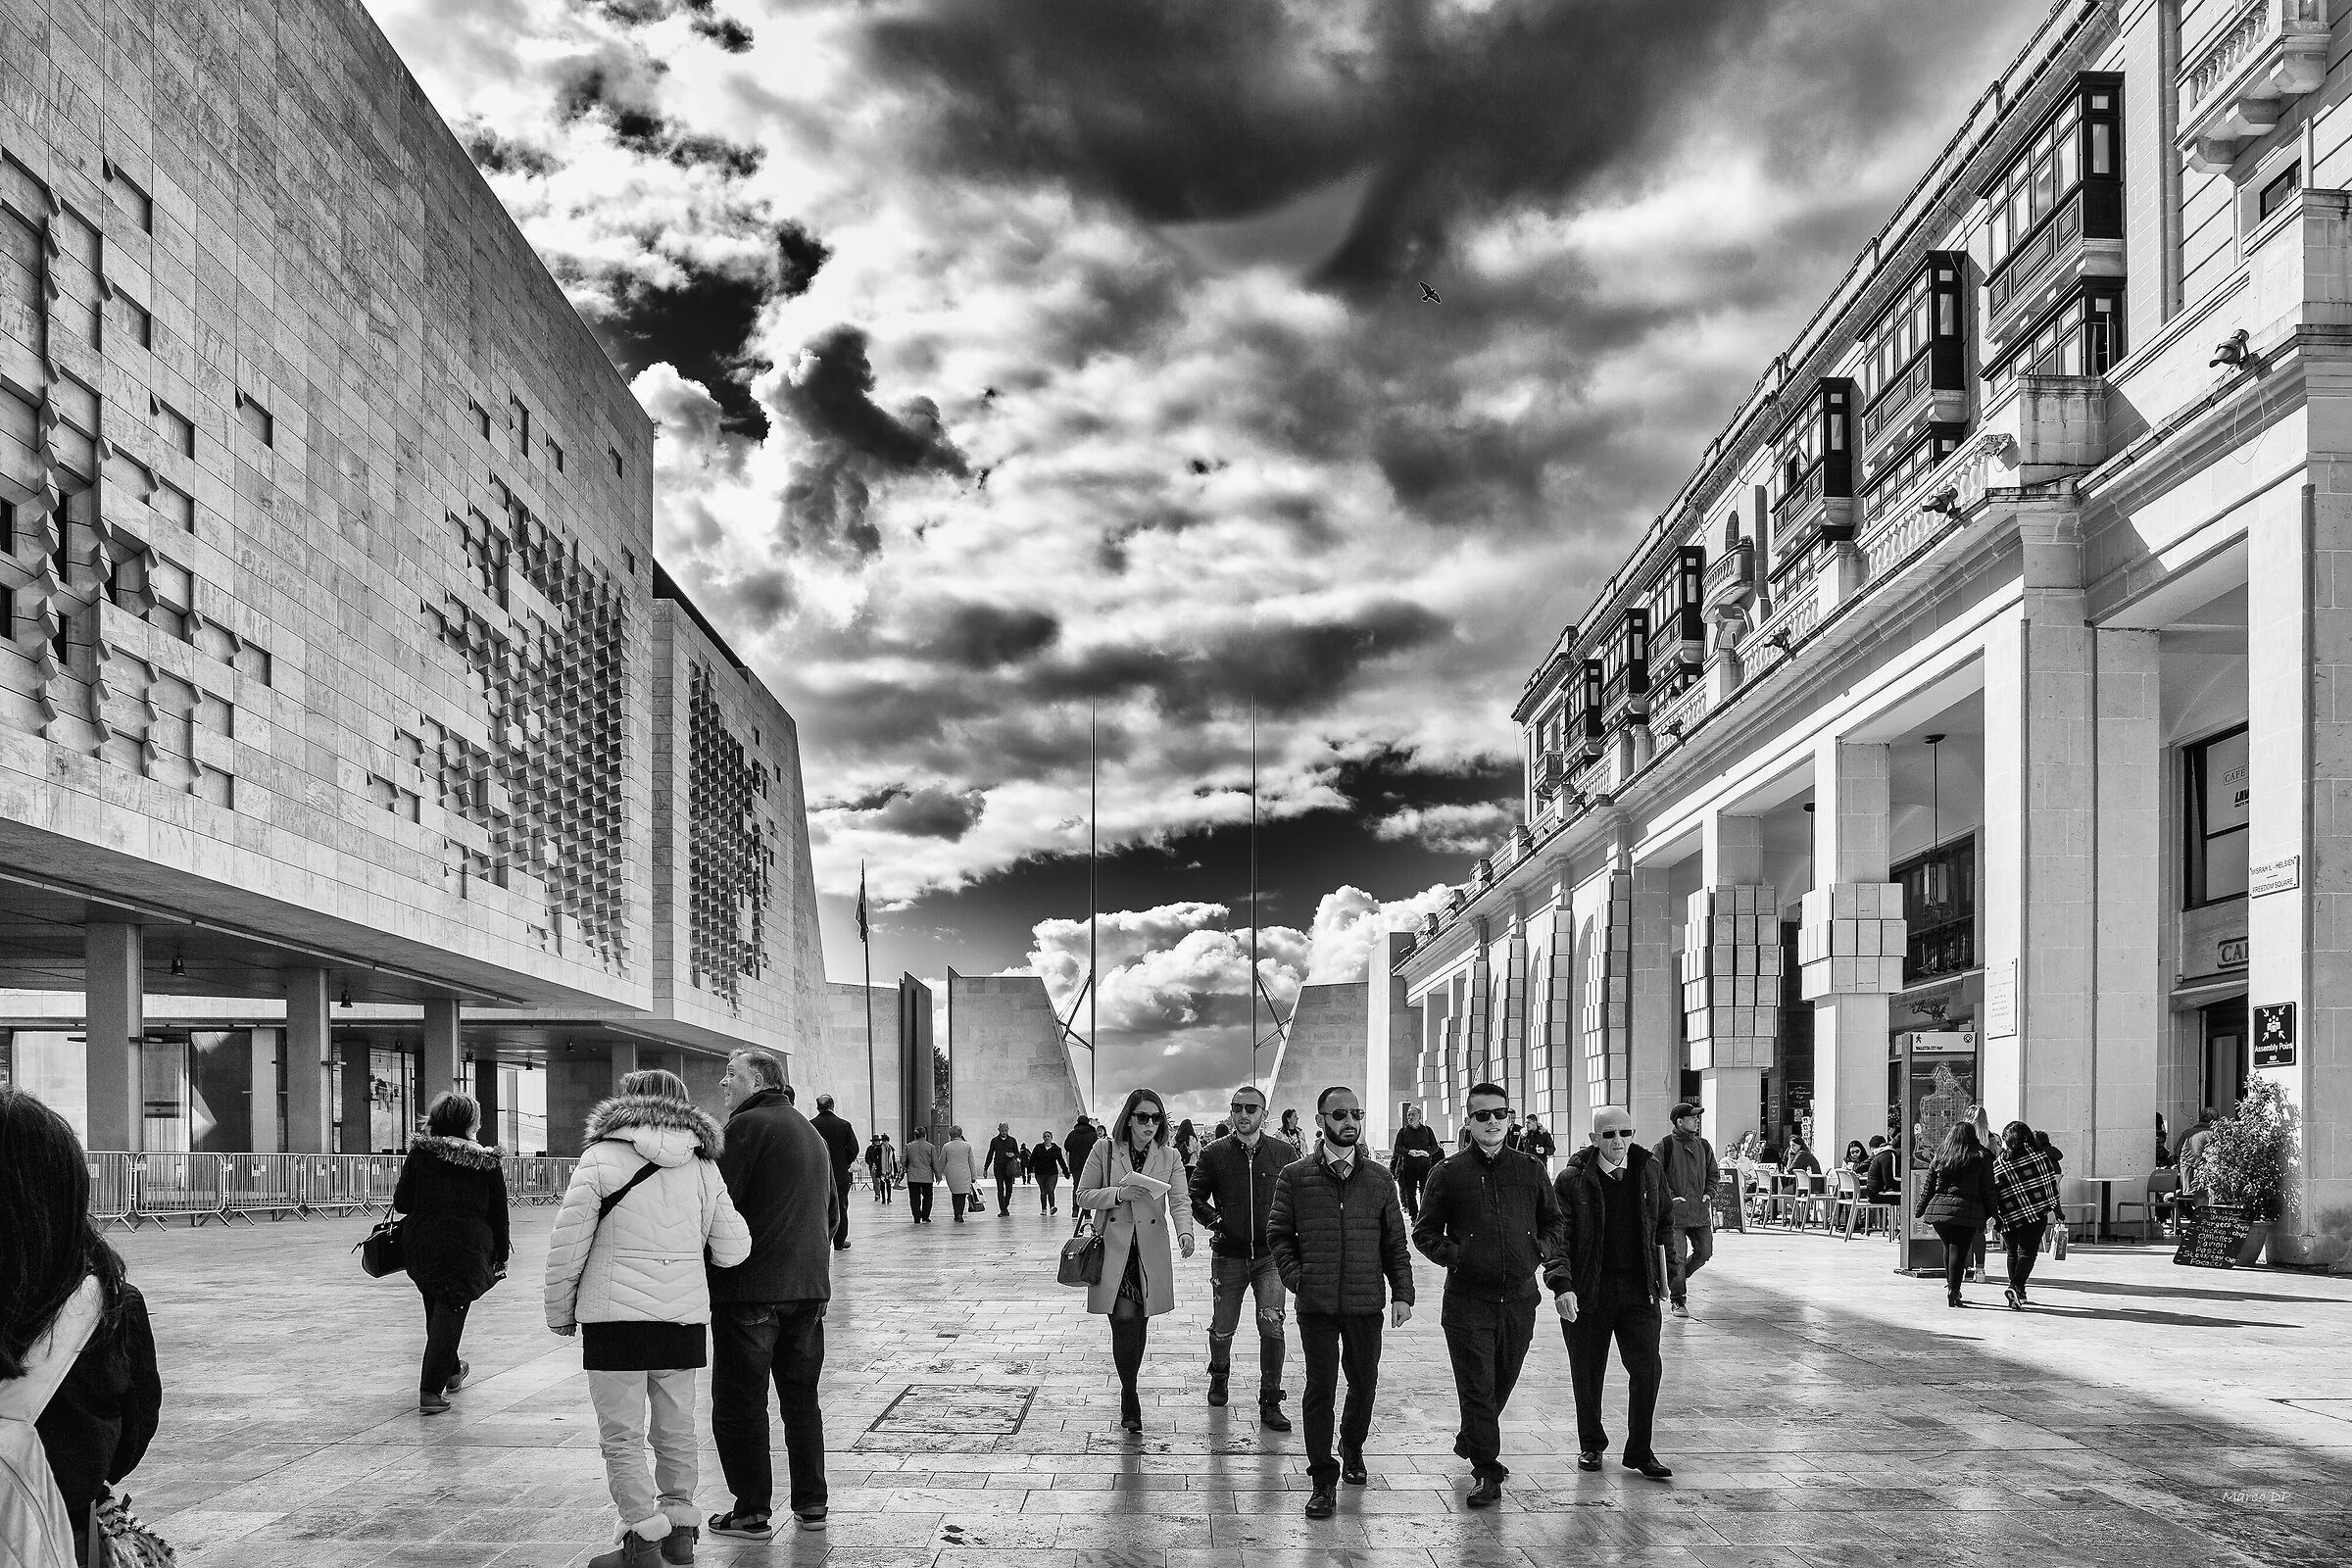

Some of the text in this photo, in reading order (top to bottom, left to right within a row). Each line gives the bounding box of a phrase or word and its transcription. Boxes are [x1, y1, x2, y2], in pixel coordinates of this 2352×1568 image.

[2252, 877, 2294, 893] FREEDOM SQUARE
[2254, 1041, 2294, 1053] Assembly Point
